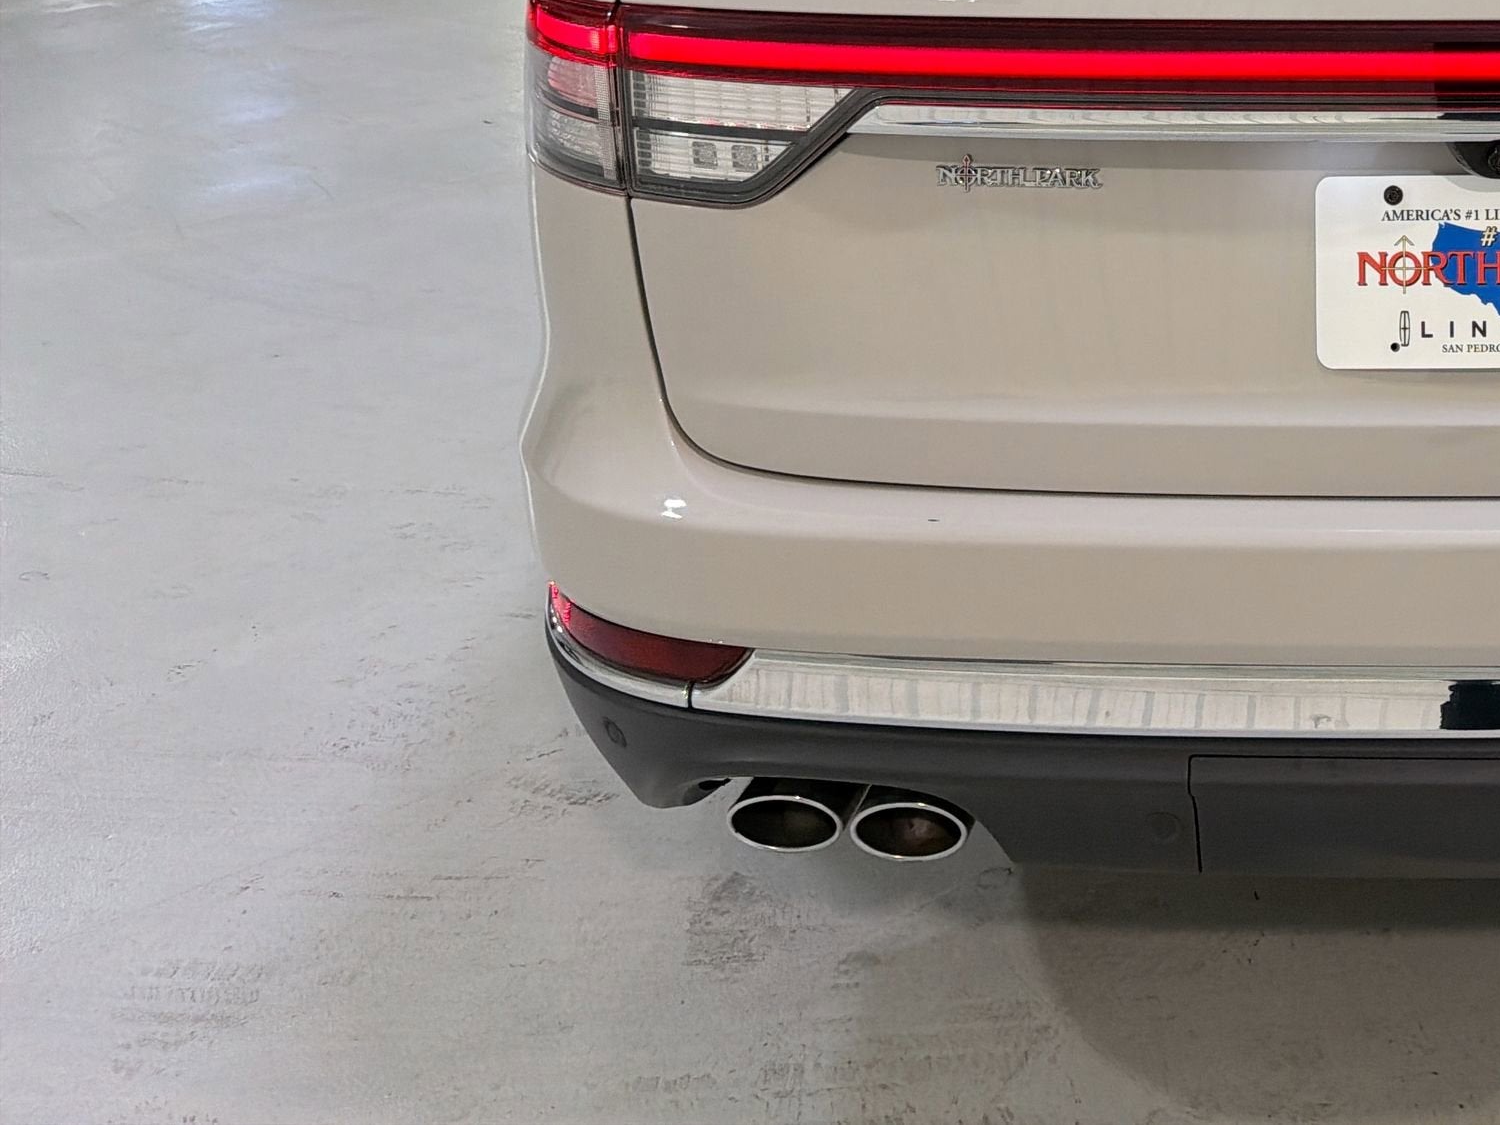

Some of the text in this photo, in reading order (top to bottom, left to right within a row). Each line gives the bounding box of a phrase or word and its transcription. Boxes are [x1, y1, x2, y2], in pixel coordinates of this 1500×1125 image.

[936, 165, 1103, 189] NORTH PARK
[1381, 209, 1462, 221] AMERICA'S
[1464, 209, 1480, 221] #1
[1441, 344, 1464, 353] SAN
